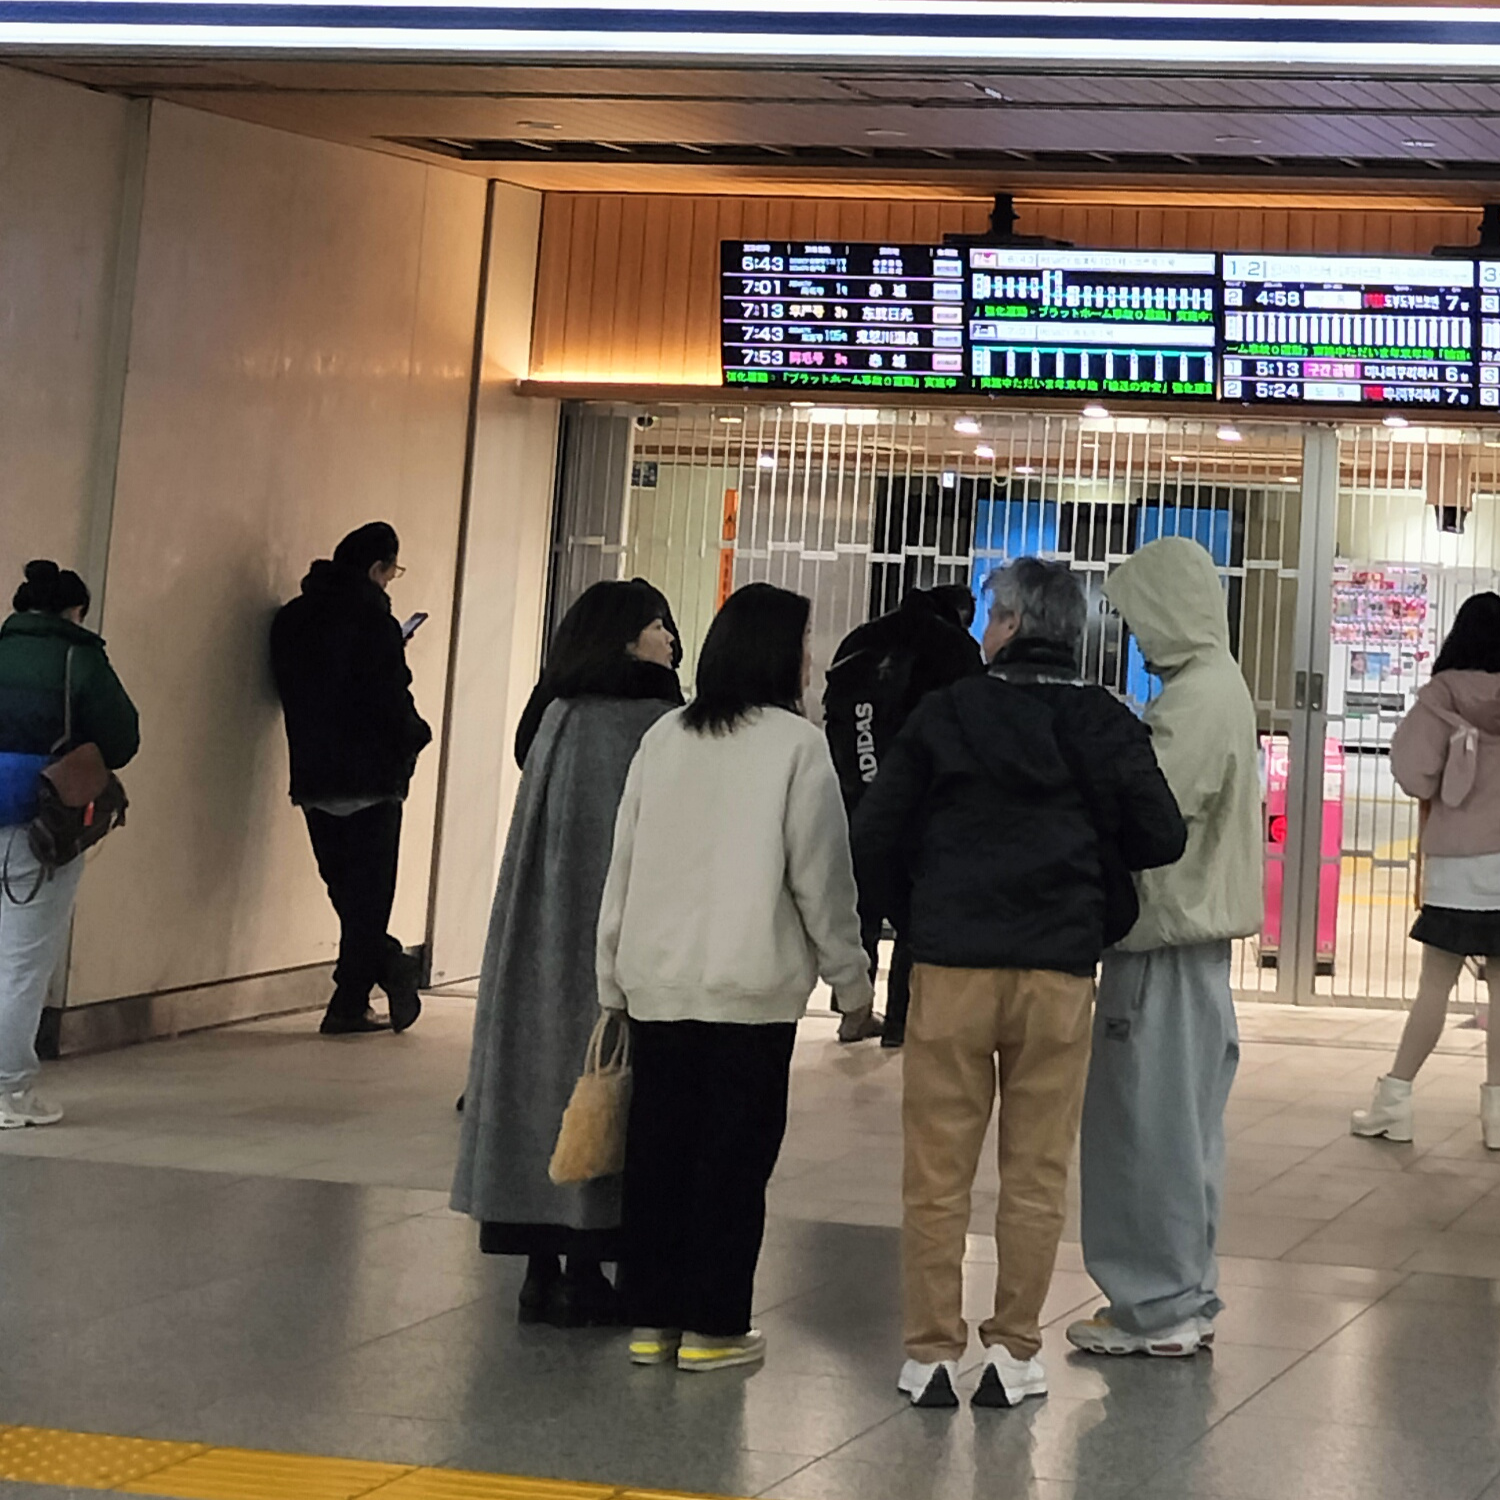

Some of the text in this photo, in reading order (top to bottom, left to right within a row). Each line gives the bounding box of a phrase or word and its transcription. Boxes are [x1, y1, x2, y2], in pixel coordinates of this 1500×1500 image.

[741, 256, 784, 272] 6:43
[741, 279, 782, 295] 7:01
[1227, 291, 1239, 304] 2
[1255, 291, 1301, 306] 4:58
[1484, 297, 1496, 311] 3
[740, 302, 784, 318] 7:13
[741, 326, 784, 341] 7:43
[740, 349, 784, 365] 7:53
[1255, 361, 1300, 377] 5:13
[1483, 369, 1495, 383] 3
[1227, 383, 1239, 396] 2
[1255, 382, 1300, 398] 5:24
[1483, 391, 1495, 405] 3
[855, 701, 880, 783] ADIDAS
